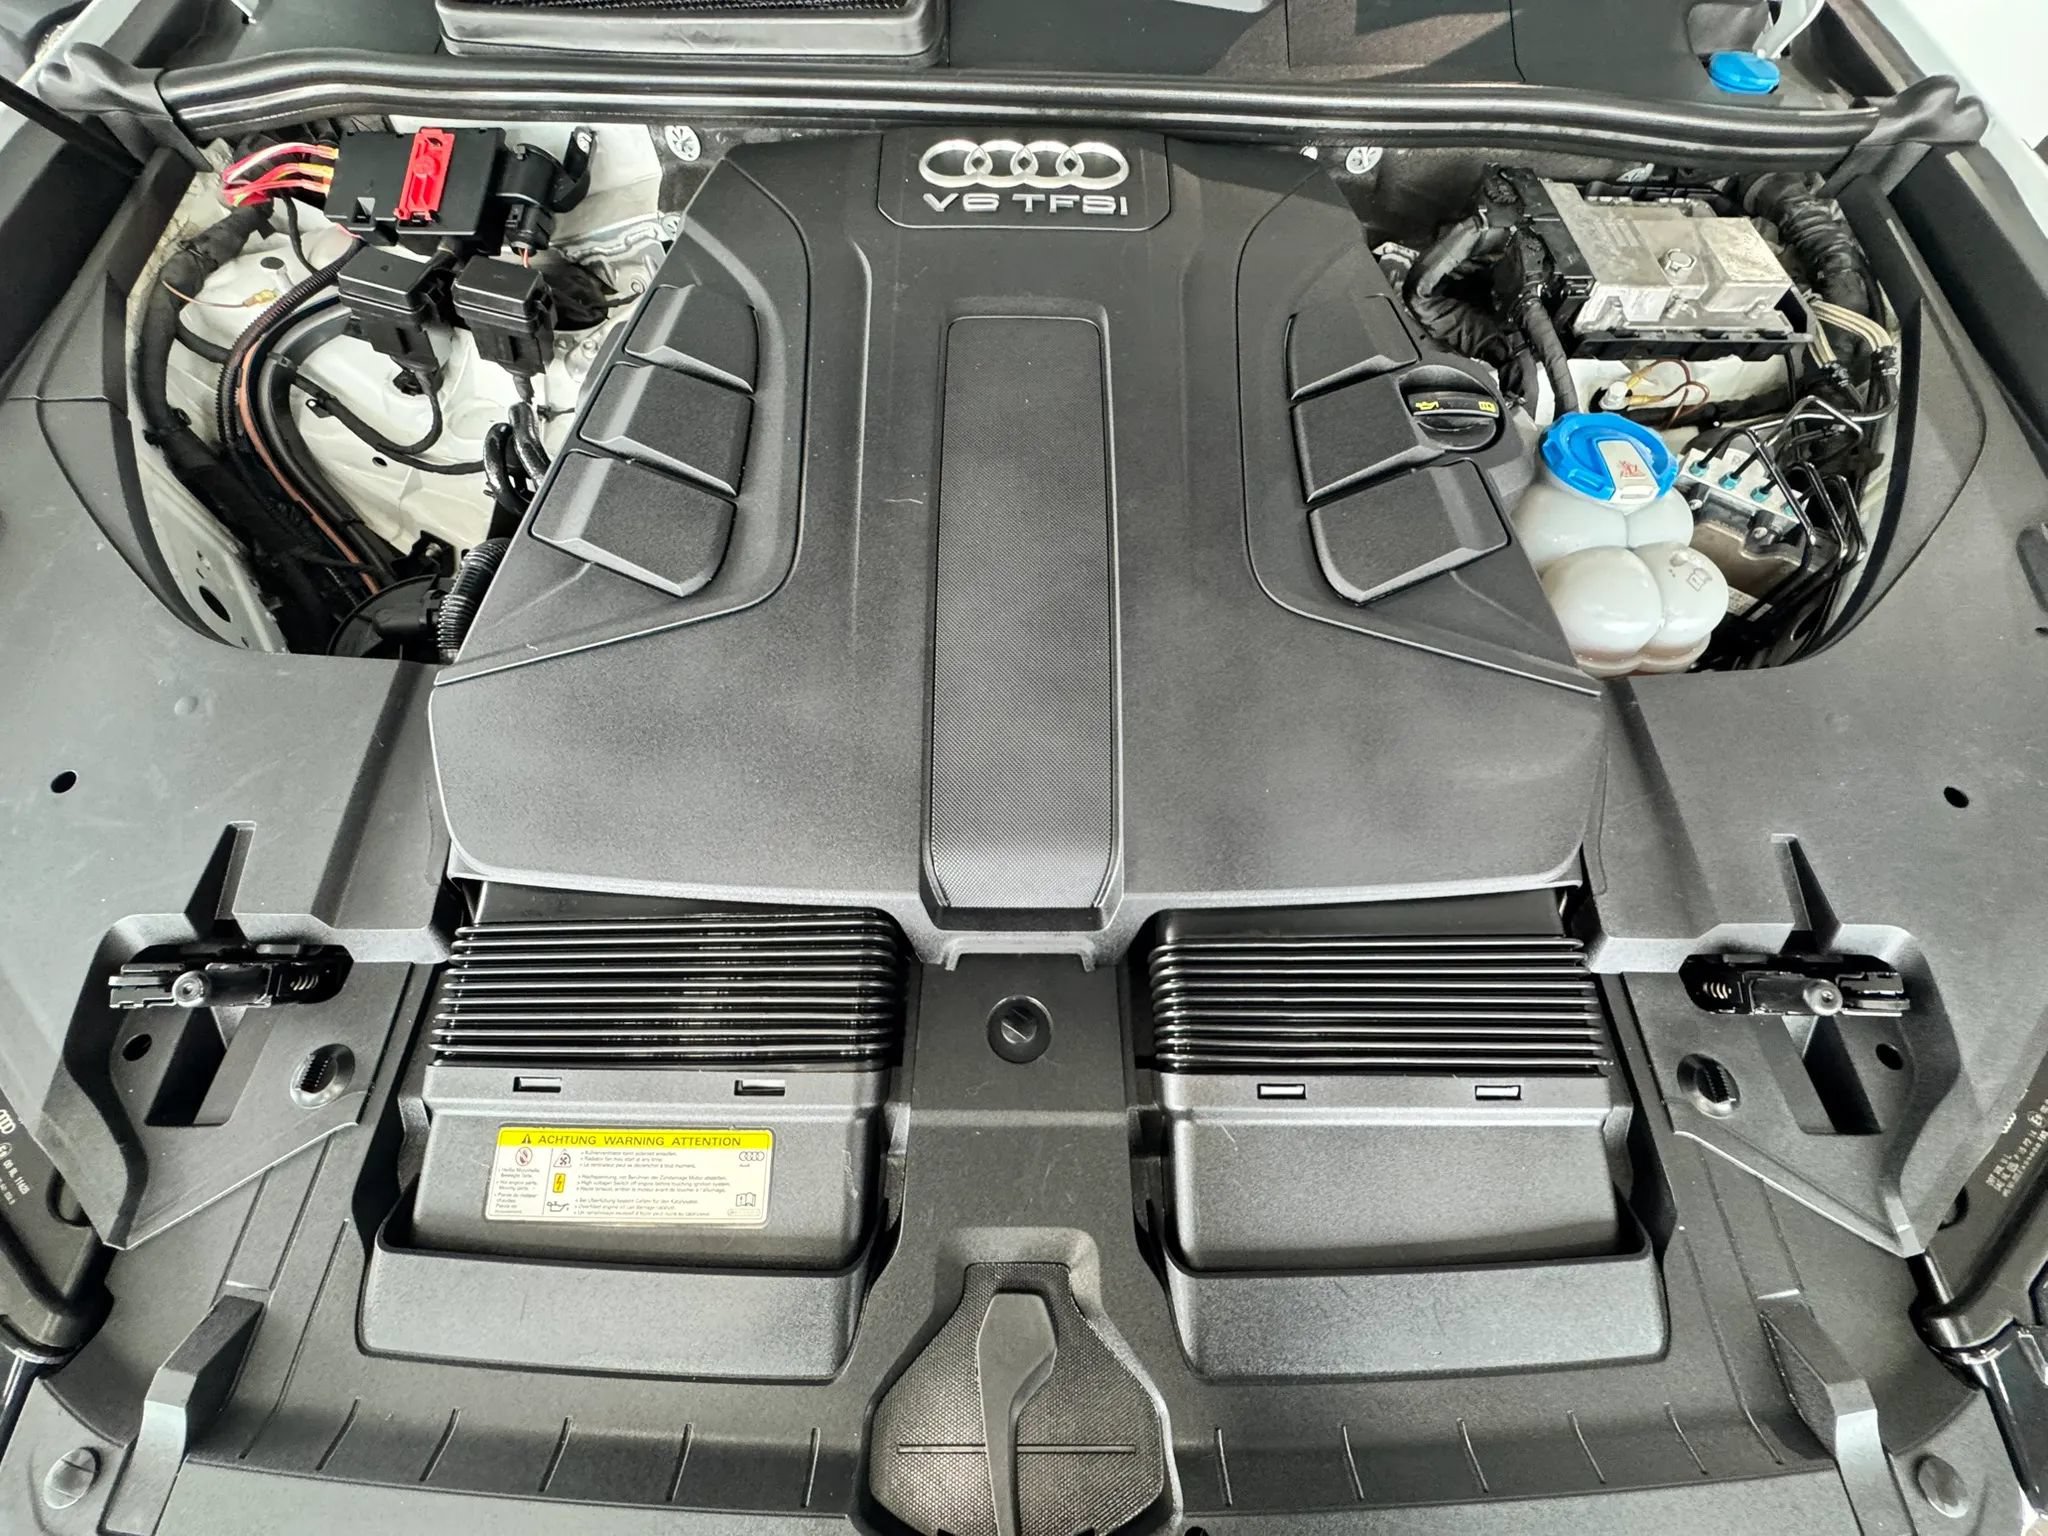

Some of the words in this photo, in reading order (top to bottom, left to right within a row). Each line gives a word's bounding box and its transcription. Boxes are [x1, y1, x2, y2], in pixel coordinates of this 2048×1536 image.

[923, 193, 1000, 212] V6
[1011, 193, 1128, 216] TFSI
[538, 1134, 597, 1145] ACHTUNG
[604, 1135, 665, 1146] WARNING
[671, 1136, 742, 1147] ATTENTION
